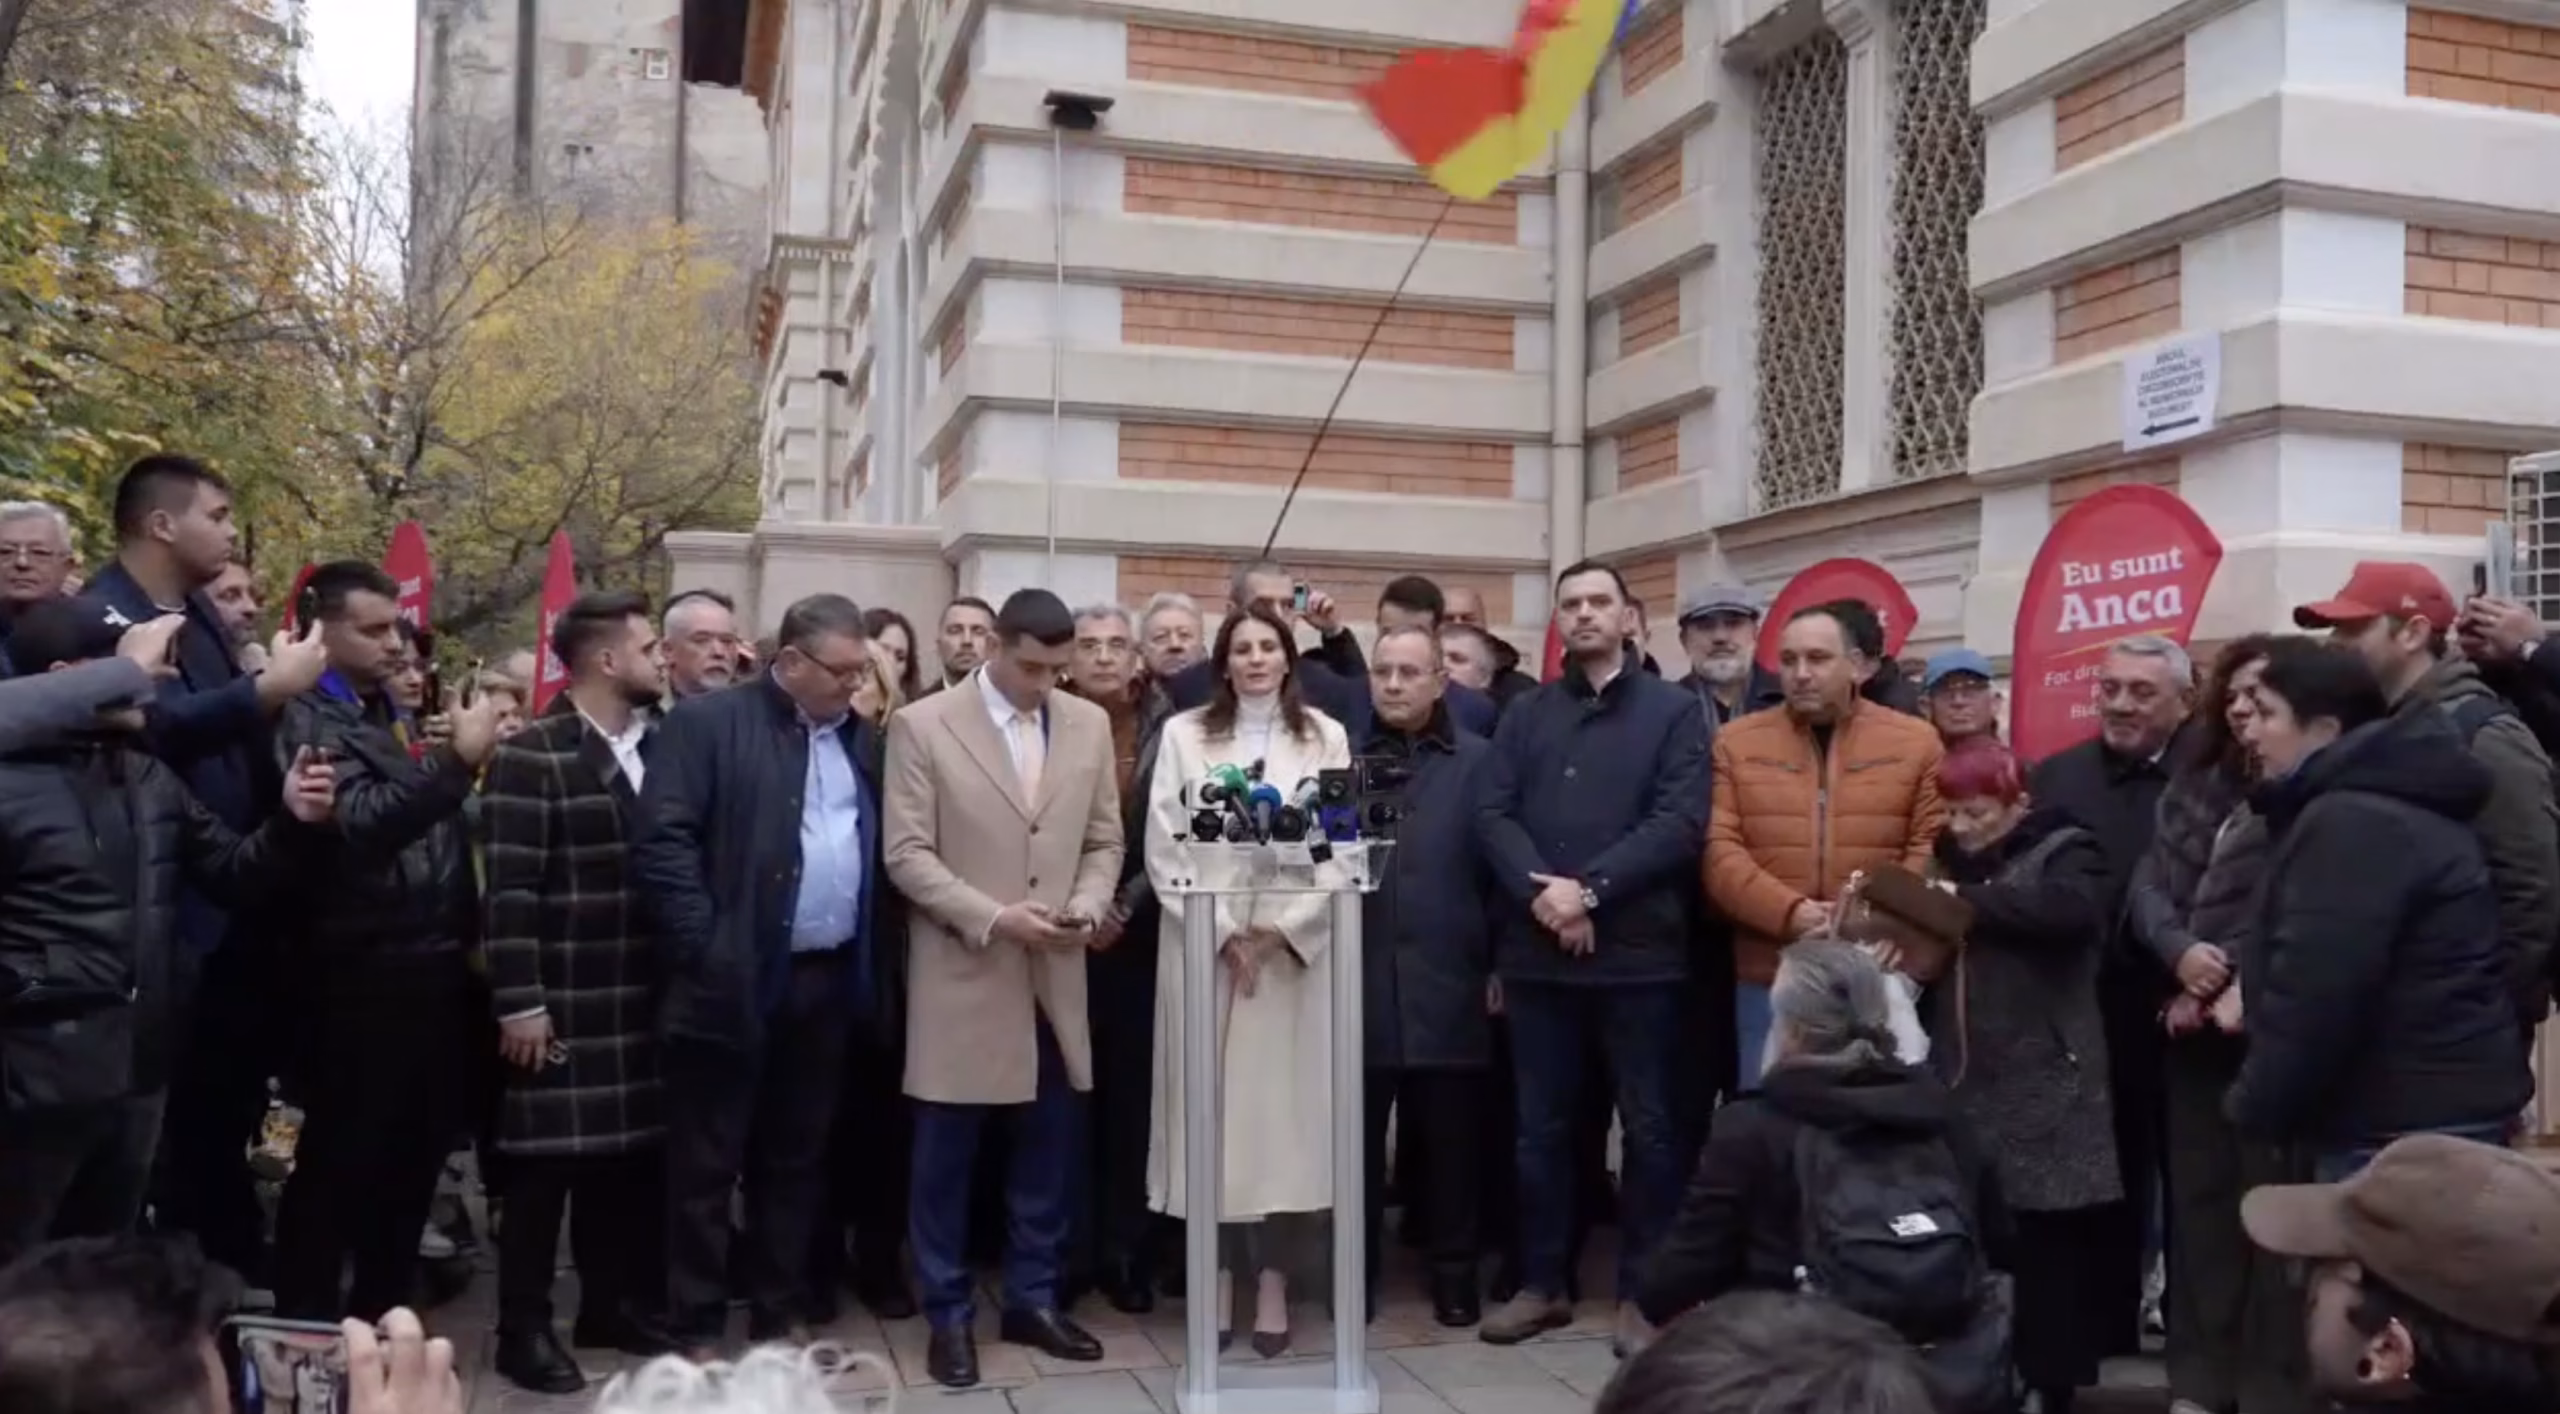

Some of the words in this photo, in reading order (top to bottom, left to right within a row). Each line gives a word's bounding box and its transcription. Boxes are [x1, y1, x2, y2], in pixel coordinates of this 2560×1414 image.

[2062, 561, 2102, 587] Eu
[2110, 546, 2184, 581] sunt
[2056, 584, 2184, 633] Anca
